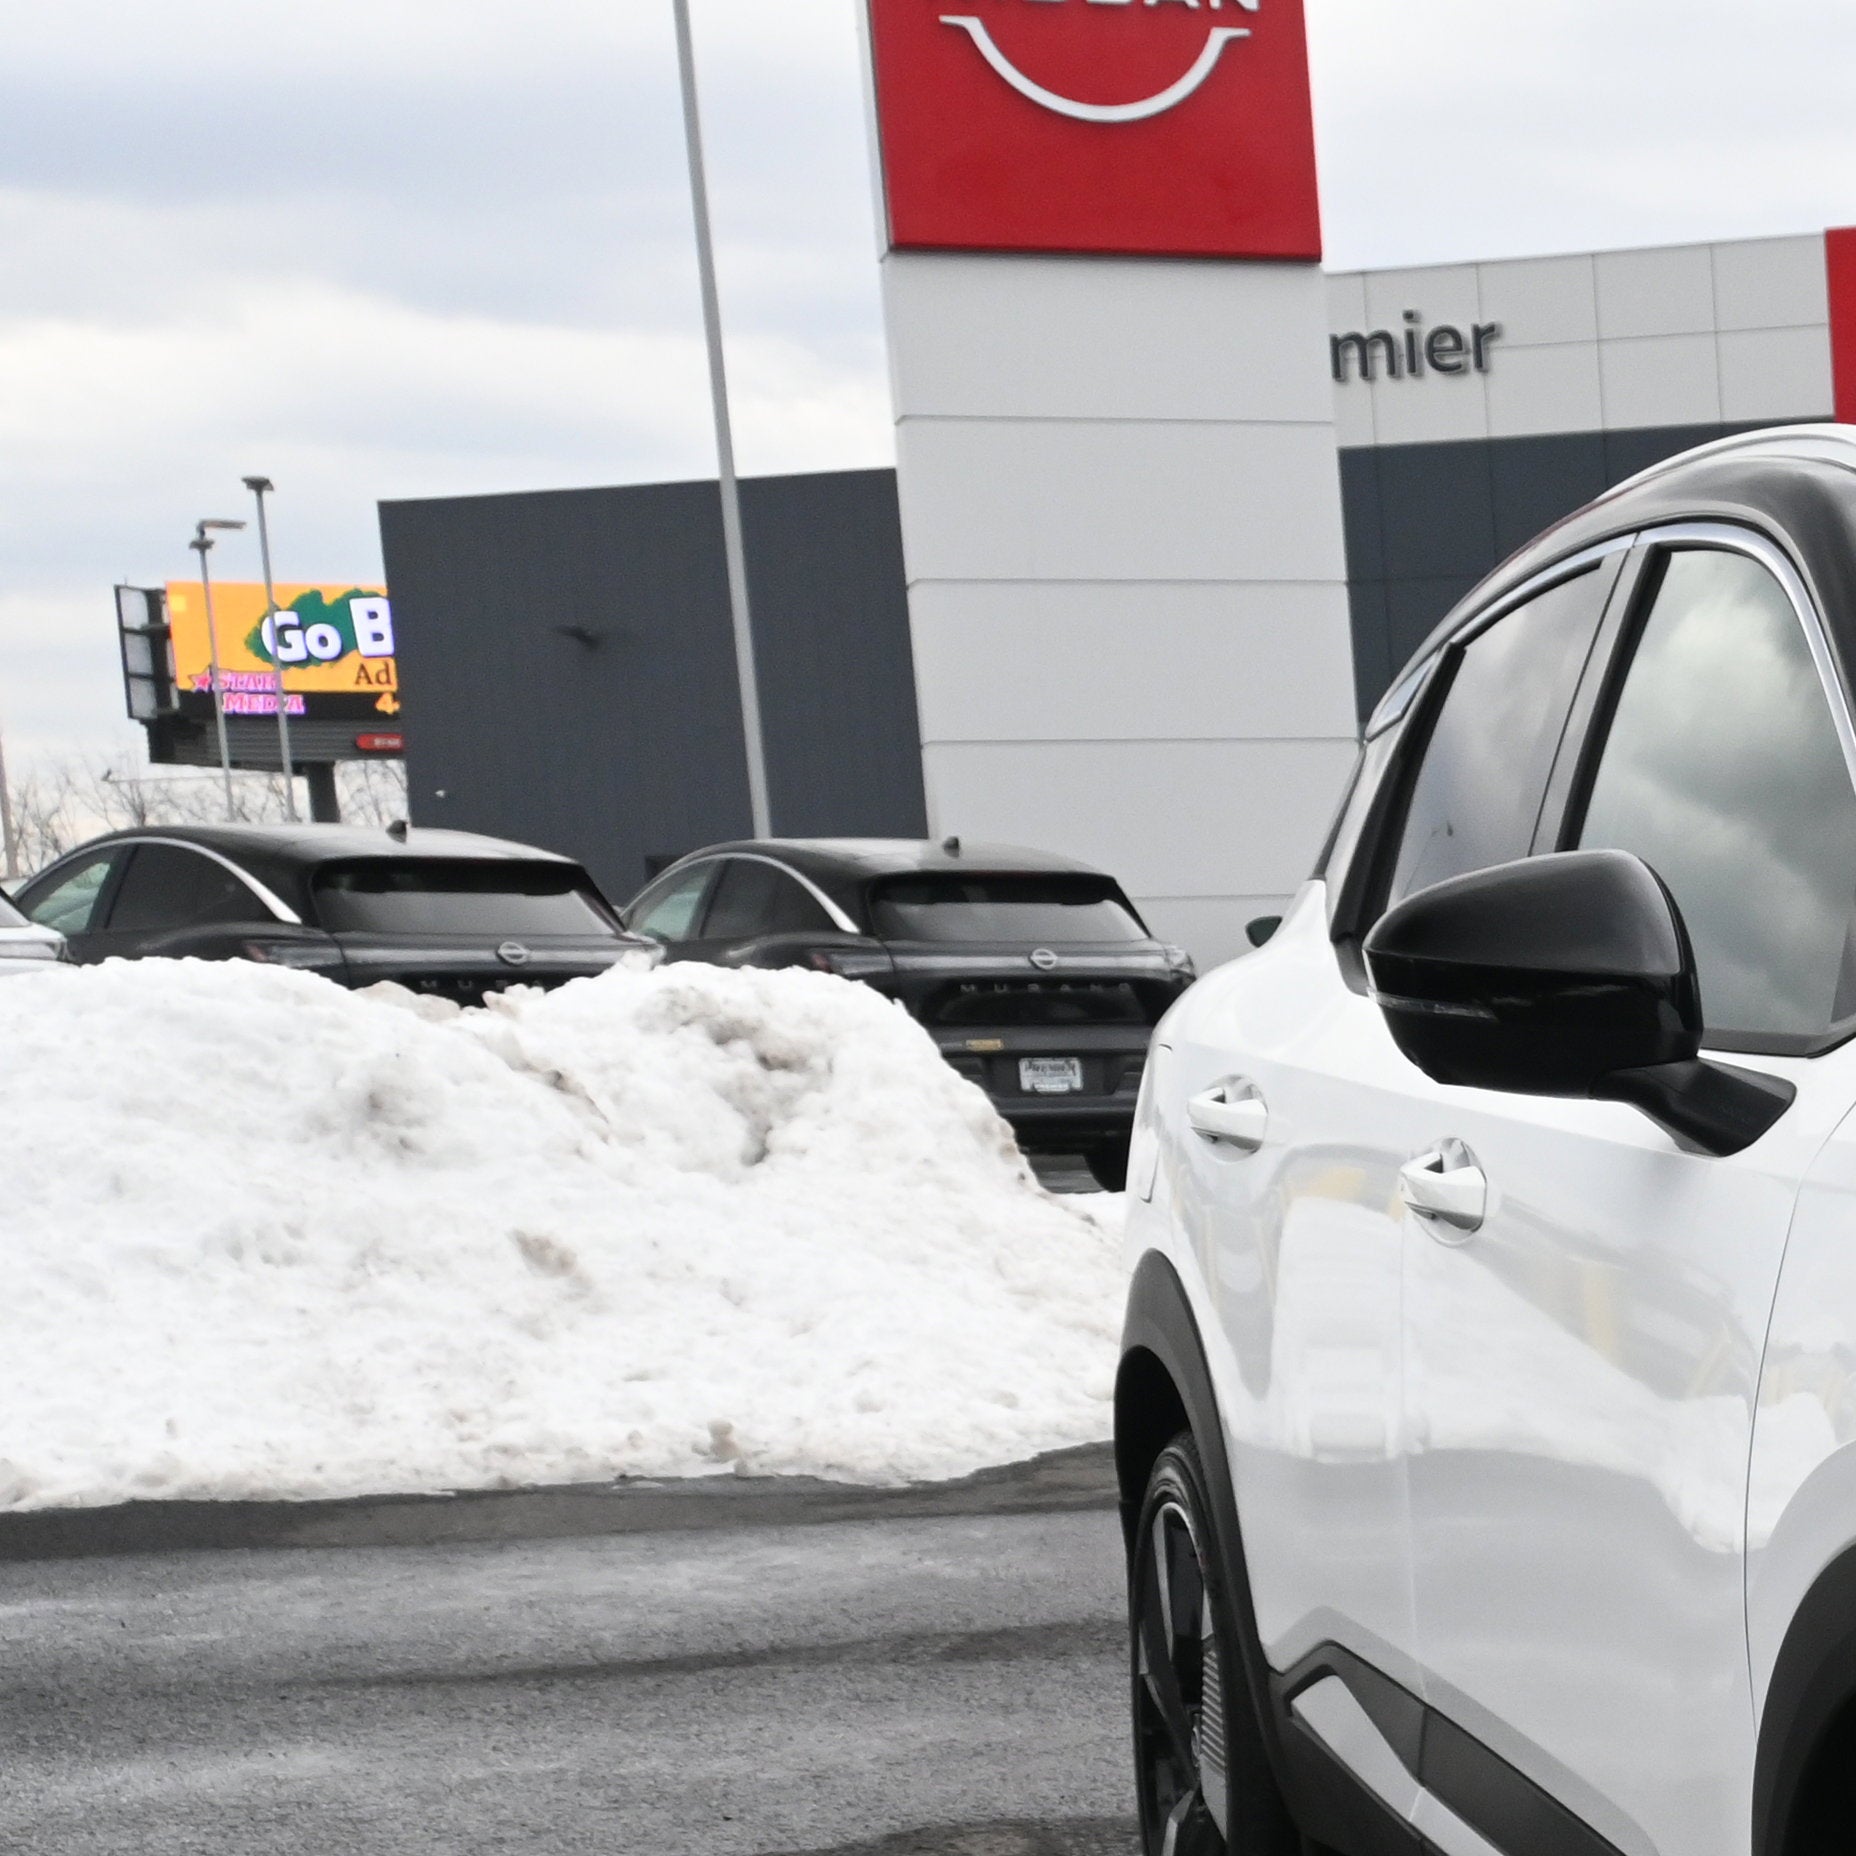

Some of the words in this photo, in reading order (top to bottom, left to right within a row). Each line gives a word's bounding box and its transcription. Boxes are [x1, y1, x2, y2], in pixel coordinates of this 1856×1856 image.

[1329, 309, 1502, 383] mier
[261, 610, 342, 663] Go
[222, 691, 305, 715] MEDA
